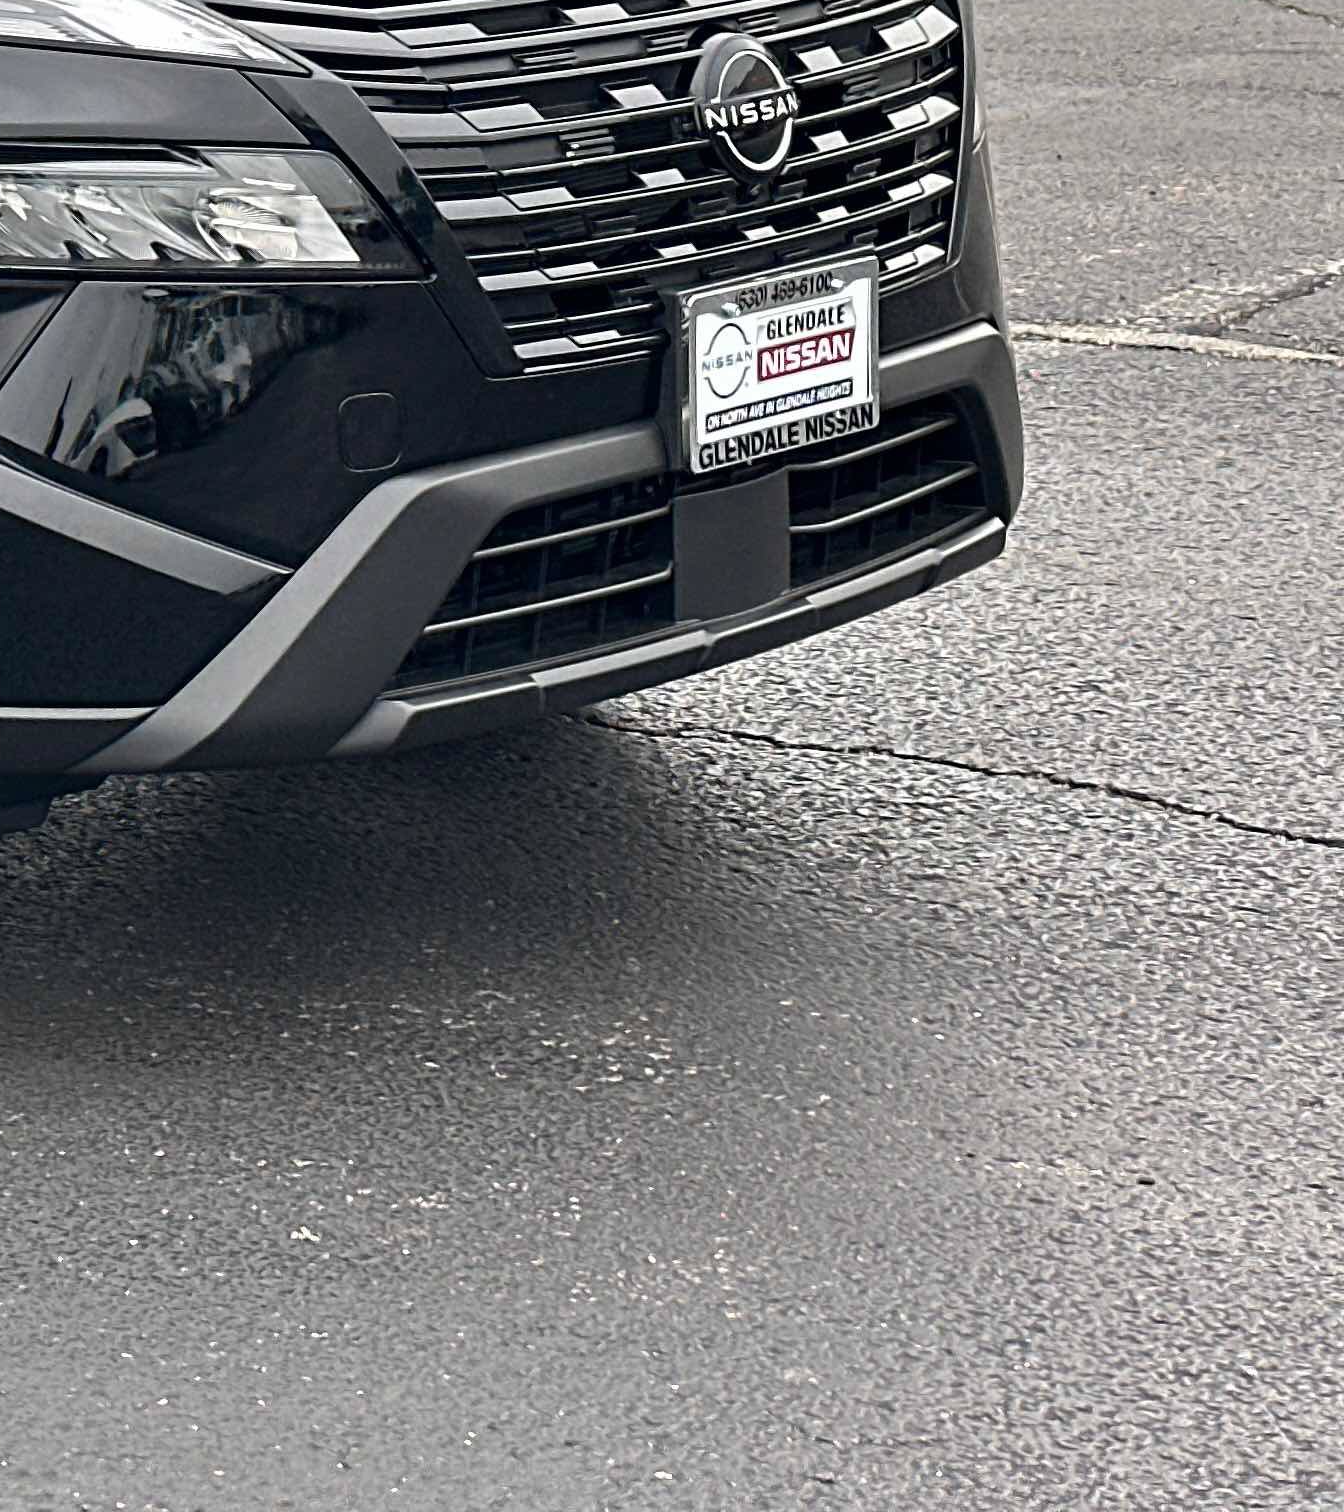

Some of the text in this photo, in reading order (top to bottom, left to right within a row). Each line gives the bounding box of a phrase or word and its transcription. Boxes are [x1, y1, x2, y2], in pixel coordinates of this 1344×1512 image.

[704, 92, 799, 129] NISSAN
[767, 304, 846, 340] GLENDALE
[702, 350, 753, 371] NISSAN
[761, 333, 851, 378] NISSAN
[699, 404, 874, 469] GLENDALE NISSAN
